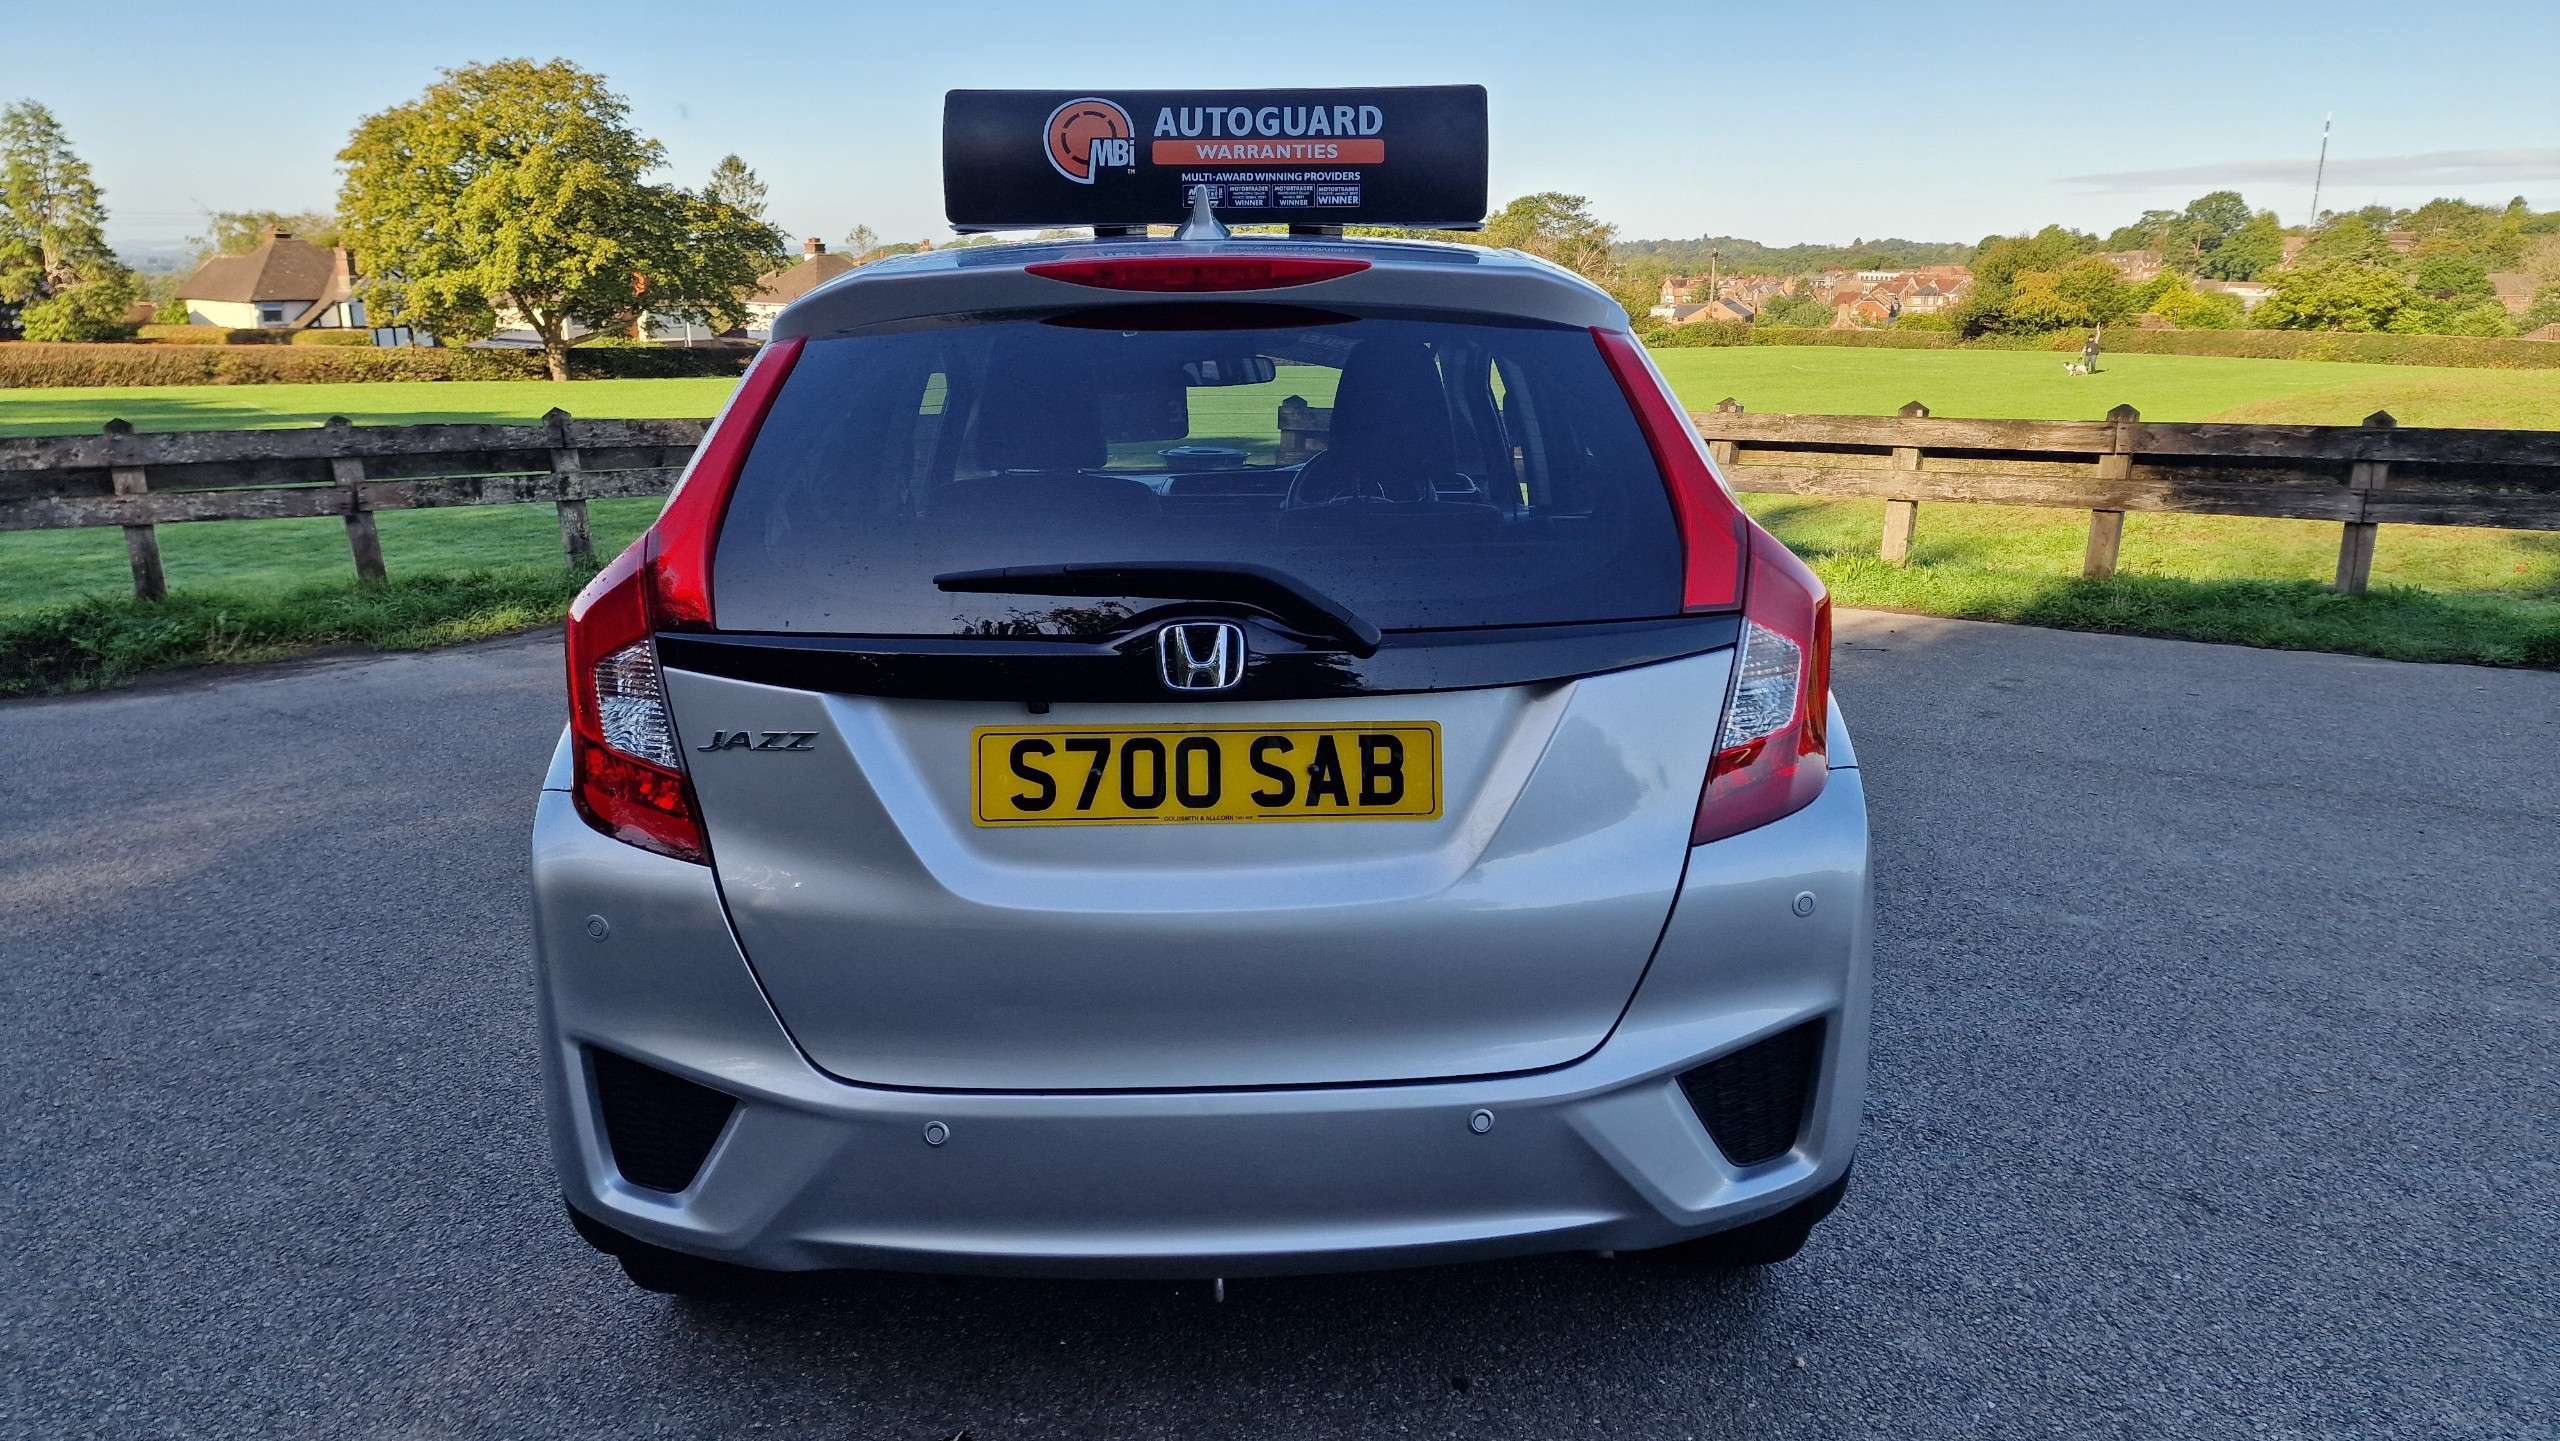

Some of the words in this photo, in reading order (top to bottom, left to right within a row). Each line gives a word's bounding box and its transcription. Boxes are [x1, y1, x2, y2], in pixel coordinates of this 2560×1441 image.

[1153, 105, 1383, 137] AUTOGUARD
[1091, 138, 1135, 167] MBi
[1196, 143, 1339, 160] WARRANTIES
[1181, 172, 1254, 182] MULTI-AWARD
[1255, 172, 1303, 182] WINNING
[1304, 171, 1361, 181] PROVIDERS
[1318, 196, 1359, 205] WINNER
[697, 729, 820, 752] JAZZ
[1010, 736, 1222, 812] S700
[1249, 734, 1405, 808] SAB
